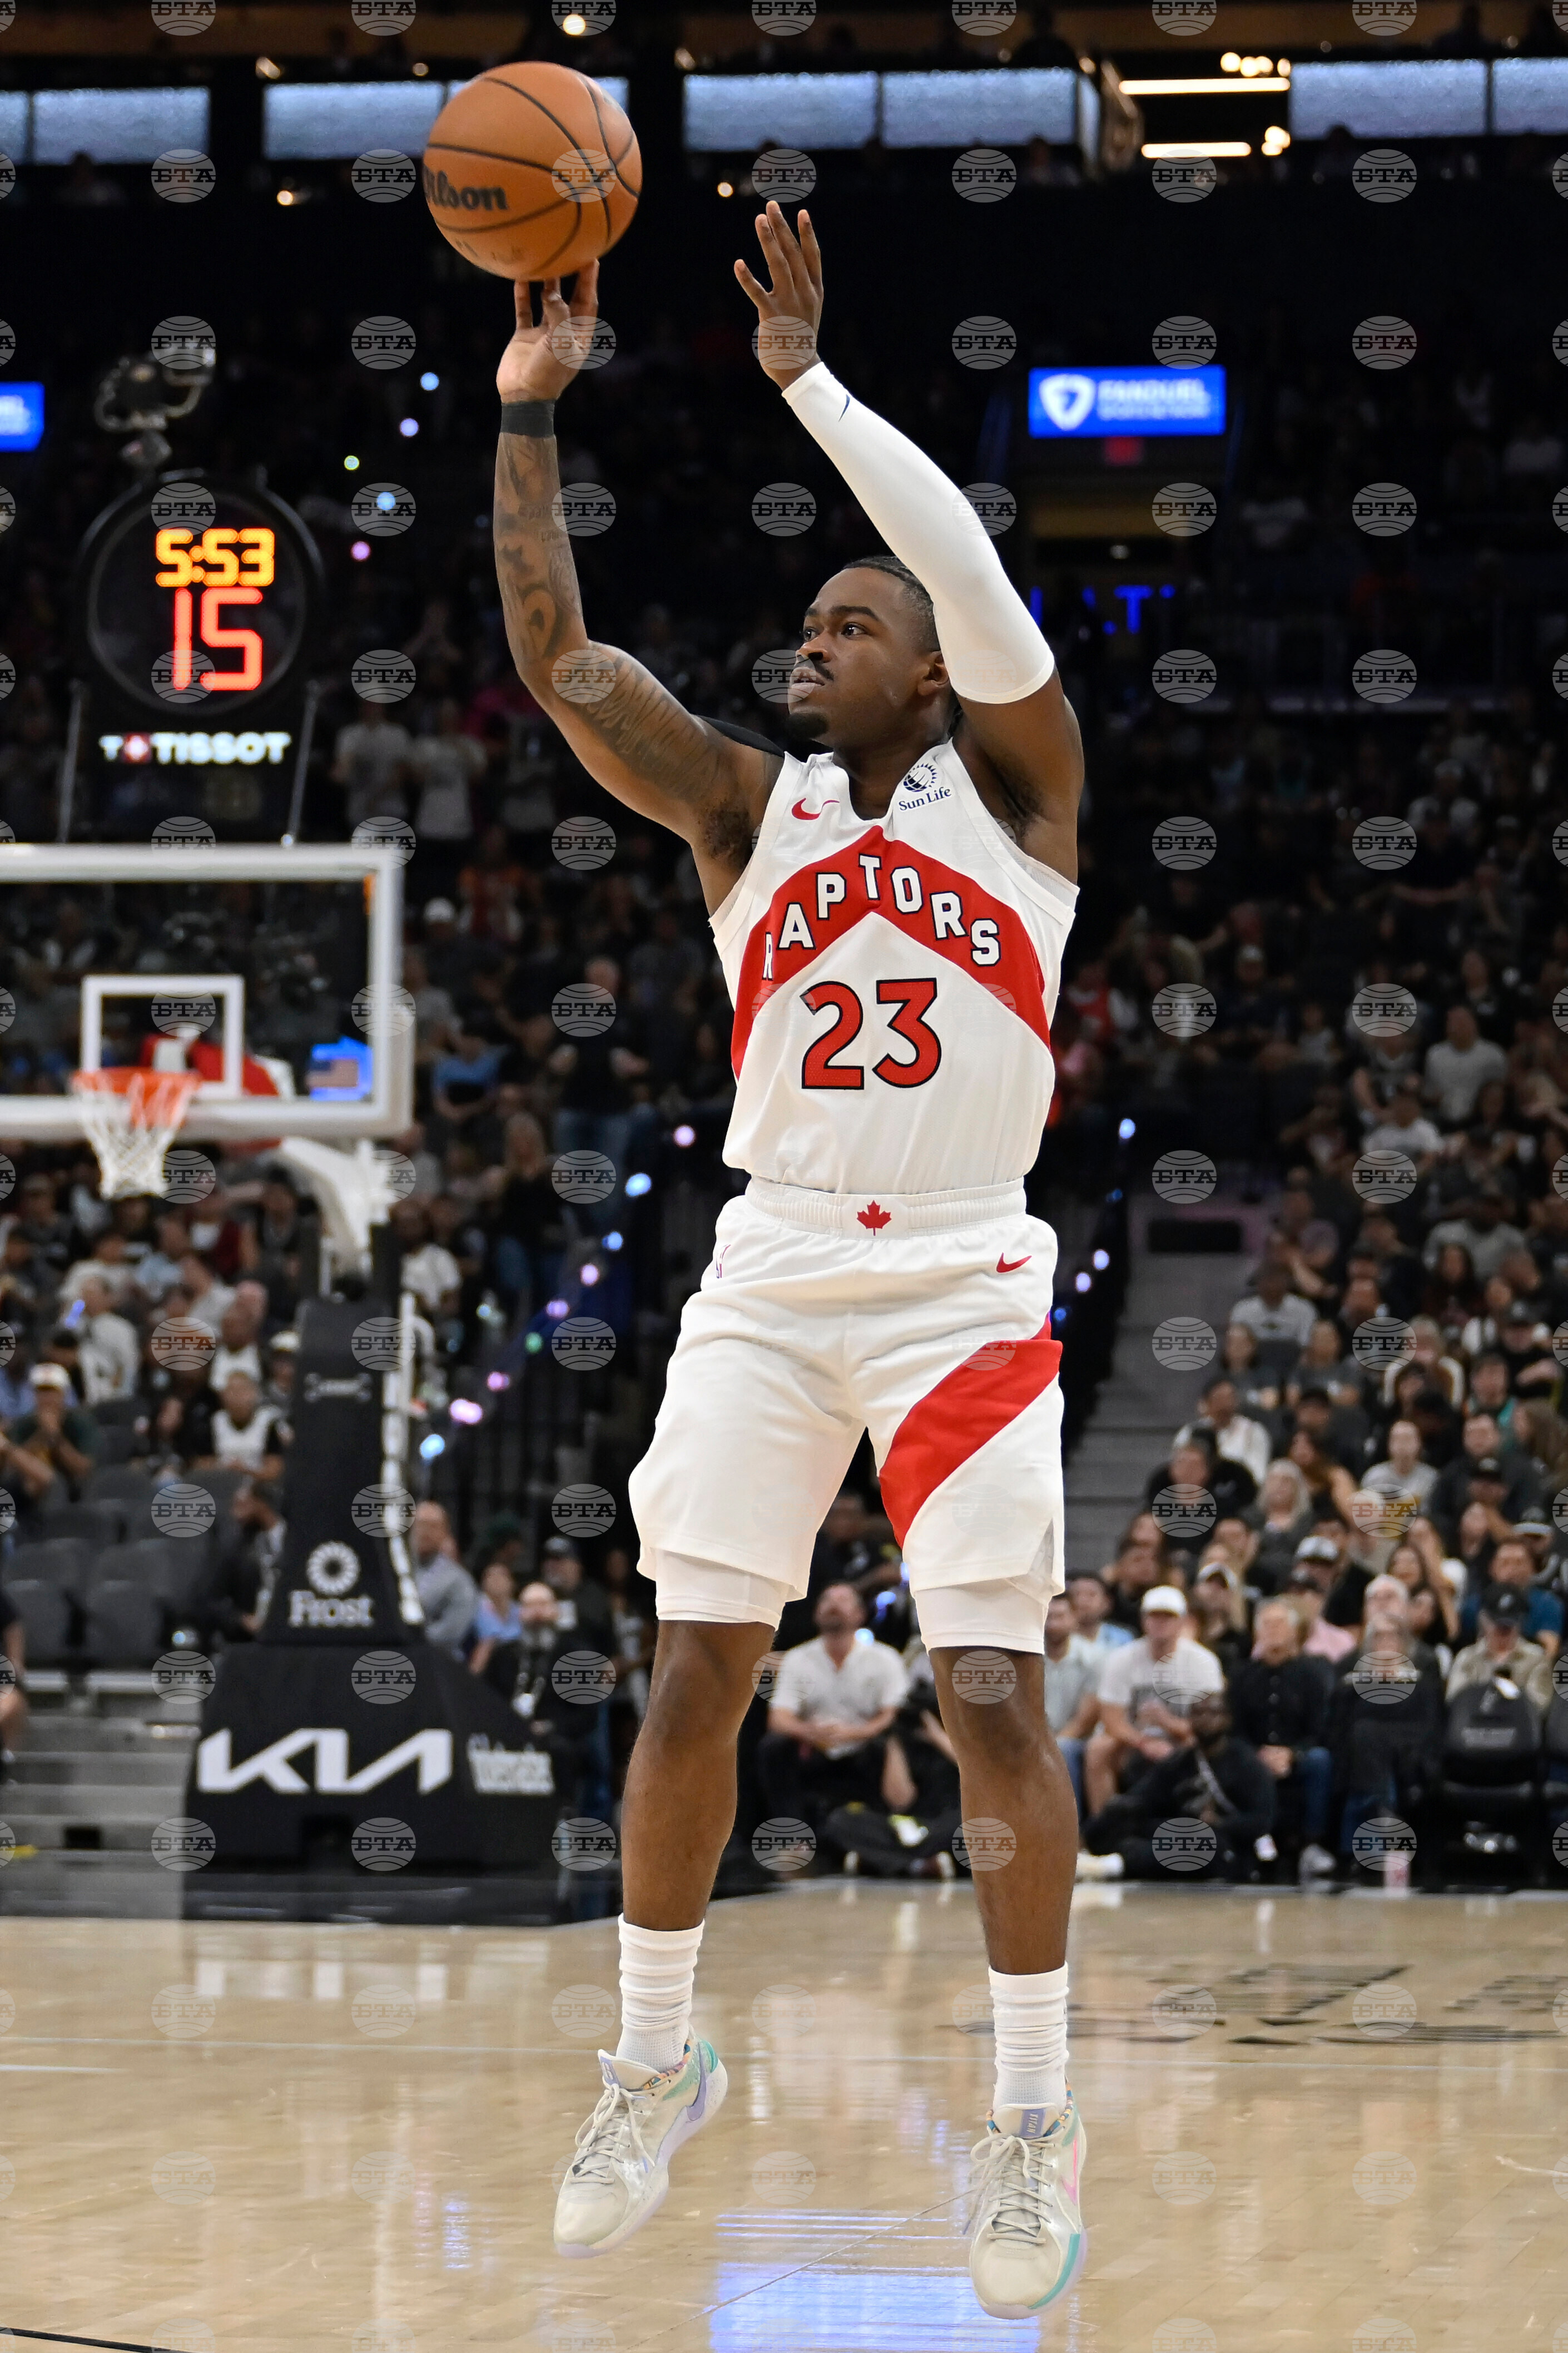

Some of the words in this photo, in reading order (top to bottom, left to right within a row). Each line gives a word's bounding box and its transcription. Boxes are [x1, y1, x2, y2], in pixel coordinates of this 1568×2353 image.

[156, 528, 275, 587] 5:53
[173, 587, 263, 690] 15
[899, 798, 925, 811] Sun
[926, 786, 952, 803] Life
[762, 854, 1001, 981] RAPTORS
[799, 978, 942, 1090] 23
[196, 1728, 452, 1795] KIA
